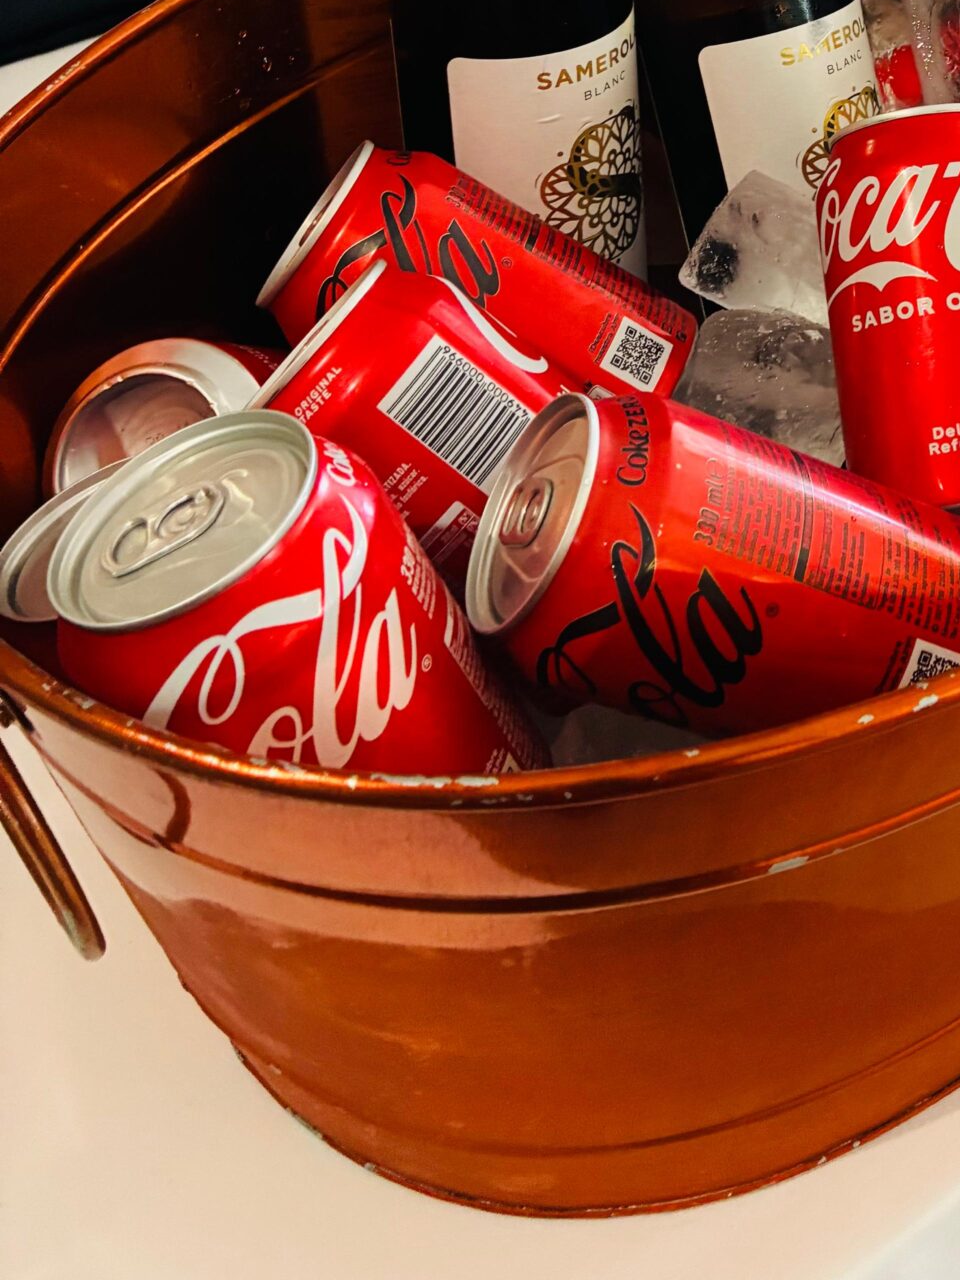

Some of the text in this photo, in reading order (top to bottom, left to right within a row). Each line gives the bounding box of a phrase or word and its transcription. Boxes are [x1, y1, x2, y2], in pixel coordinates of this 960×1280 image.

[826, 48, 863, 76] BLANC
[583, 70, 627, 102] BLANC
[852, 295, 936, 333] SABOR
[294, 365, 343, 417] ORIGINAL
[299, 391, 332, 424] TASTE
[616, 429, 651, 487] Coke
